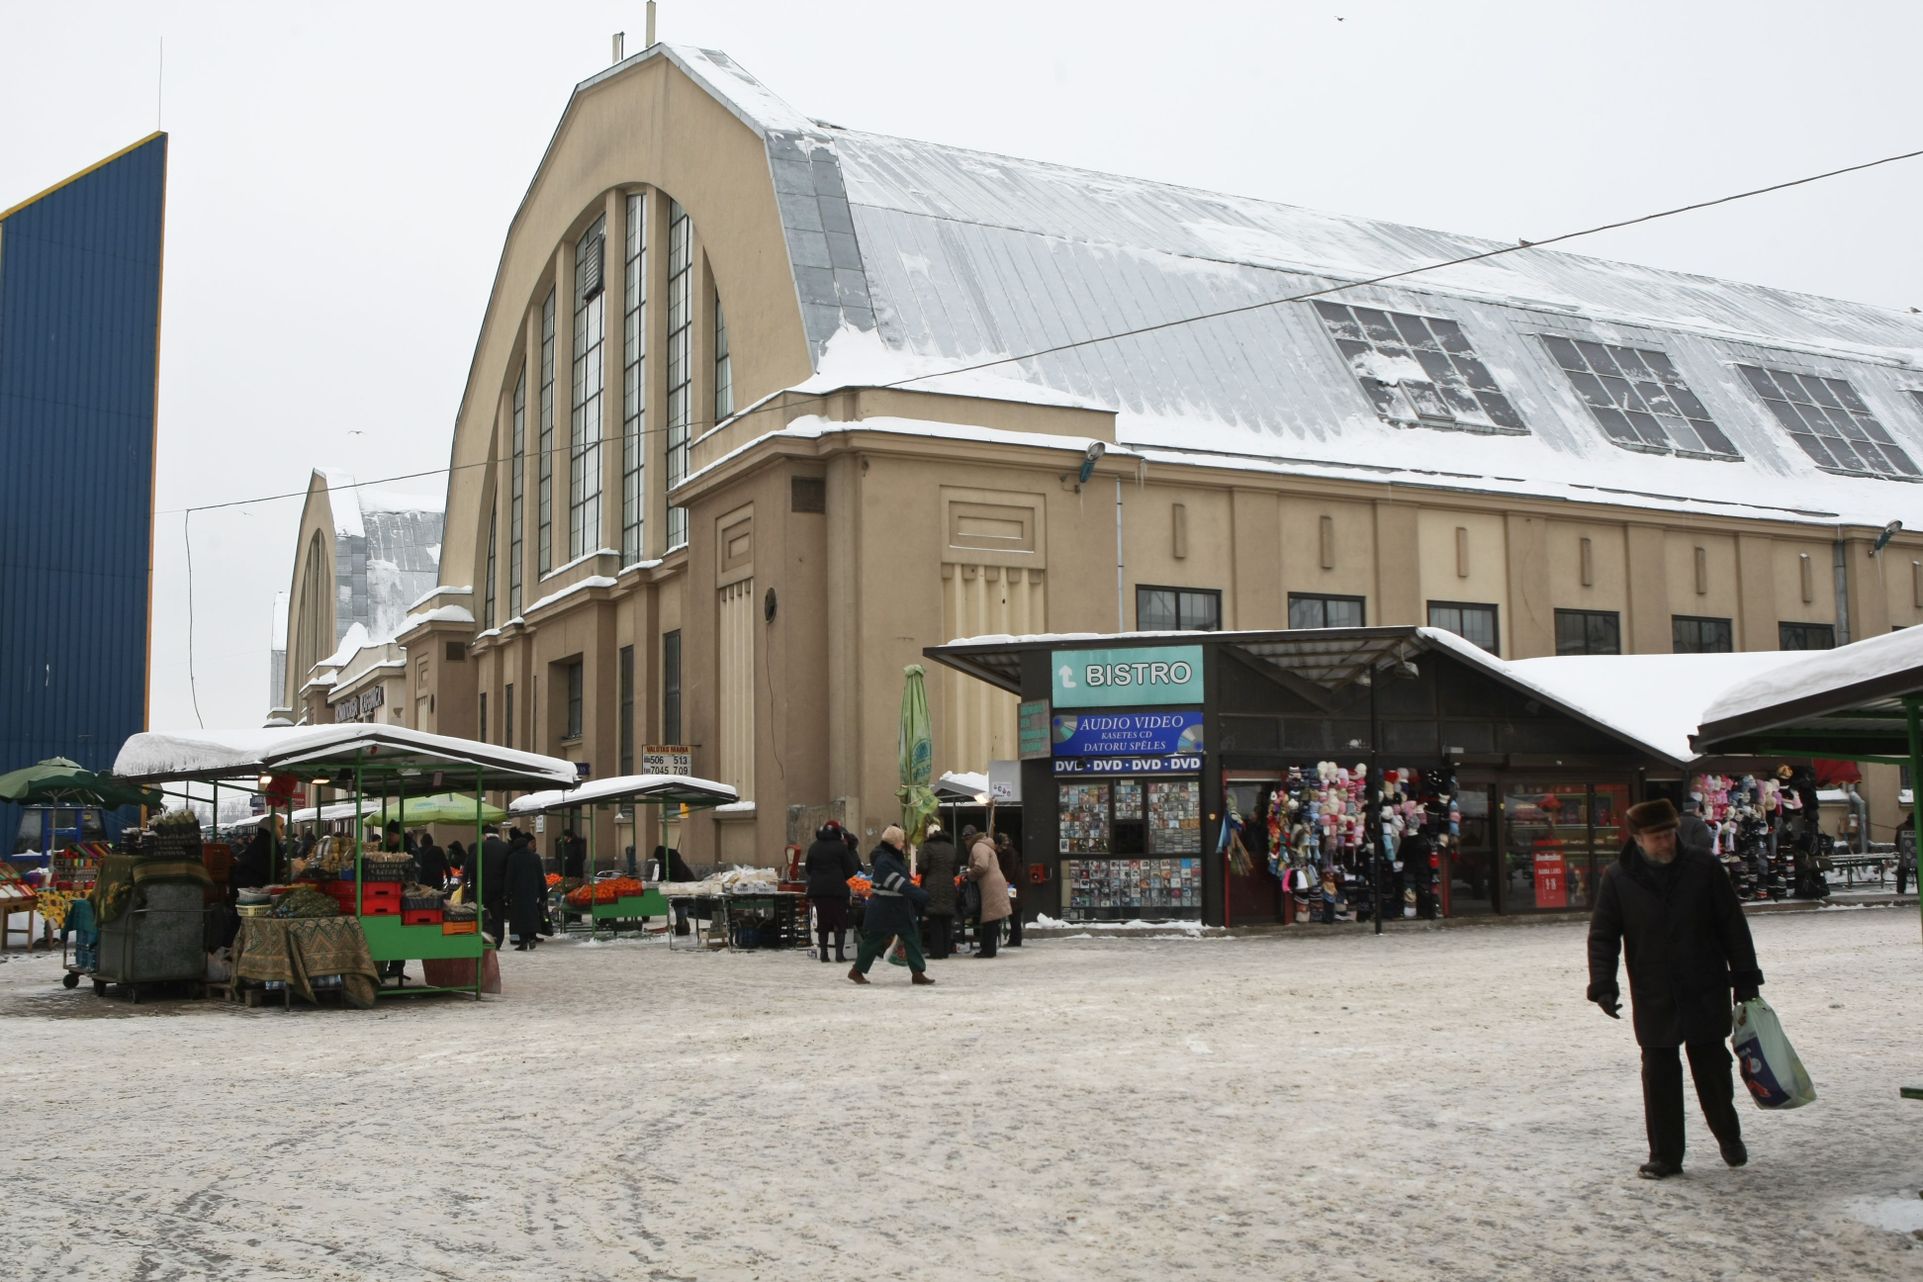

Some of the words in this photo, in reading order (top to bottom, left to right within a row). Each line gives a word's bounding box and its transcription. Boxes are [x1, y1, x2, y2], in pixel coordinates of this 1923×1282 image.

[1085, 661, 1193, 687] BISTRO
[1080, 717, 1130, 731] AUDIO
[1134, 715, 1184, 730] VIDEO
[1101, 731, 1137, 740] KASETES
[1139, 730, 1153, 739] CD
[1083, 741, 1127, 752] DATORU
[1129, 739, 1166, 751] SPĒLES
[650, 755, 664, 764] 506
[673, 755, 688, 764] 513
[1093, 759, 1123, 771] DVD
[1132, 758, 1162, 770] DVD
[1170, 757, 1201, 770] DVD
[673, 766, 688, 775] 709
